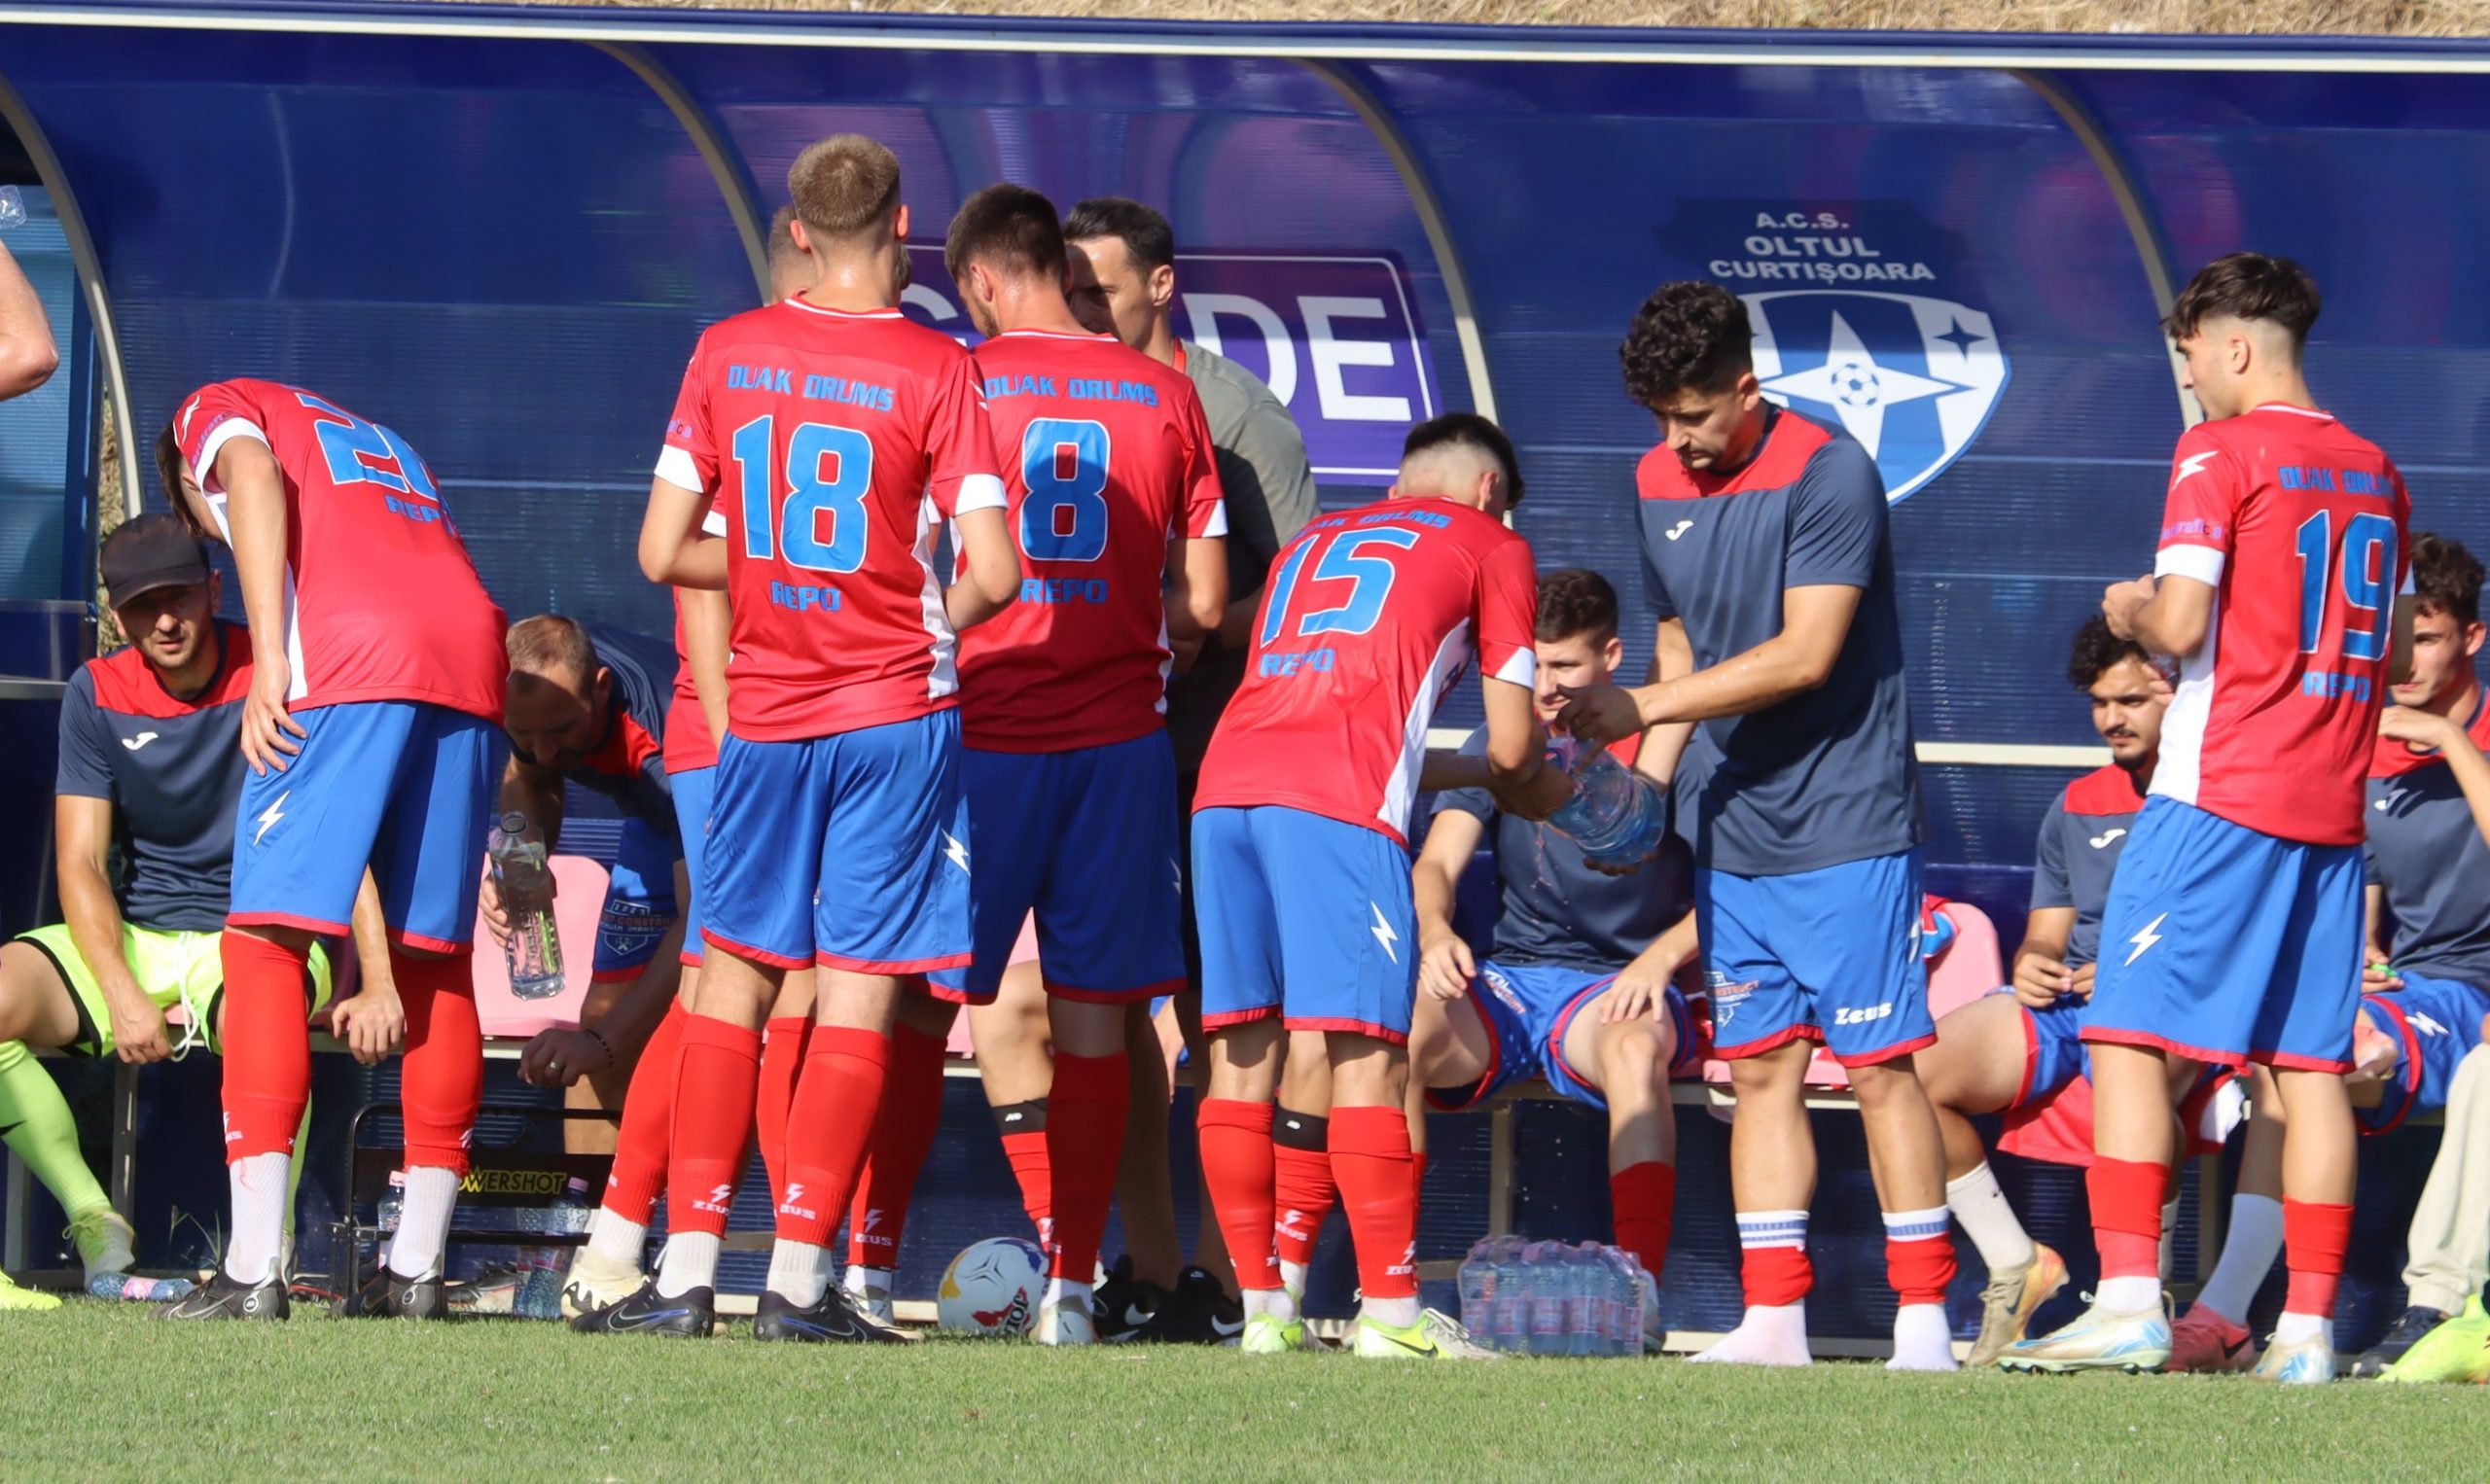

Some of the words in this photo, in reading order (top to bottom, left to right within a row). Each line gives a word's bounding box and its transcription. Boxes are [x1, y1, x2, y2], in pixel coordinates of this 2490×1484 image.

[1756, 212, 1850, 229] A.C.S.
[1744, 235, 1880, 257] OLTUL
[802, 373, 895, 412] DRUMS
[1067, 377, 1159, 407] DRUMS
[732, 414, 873, 574] 18
[1019, 417, 1111, 562] 8
[384, 493, 456, 538] REP
[771, 581, 841, 612] REPO
[1020, 579, 1107, 605] REPO
[1261, 526, 1420, 649] 15
[2295, 509, 2399, 661] 19
[458, 1167, 567, 1194] WERSHOT
[855, 1232, 892, 1246] ZEUS
[1385, 1265, 1418, 1276] ZEU
